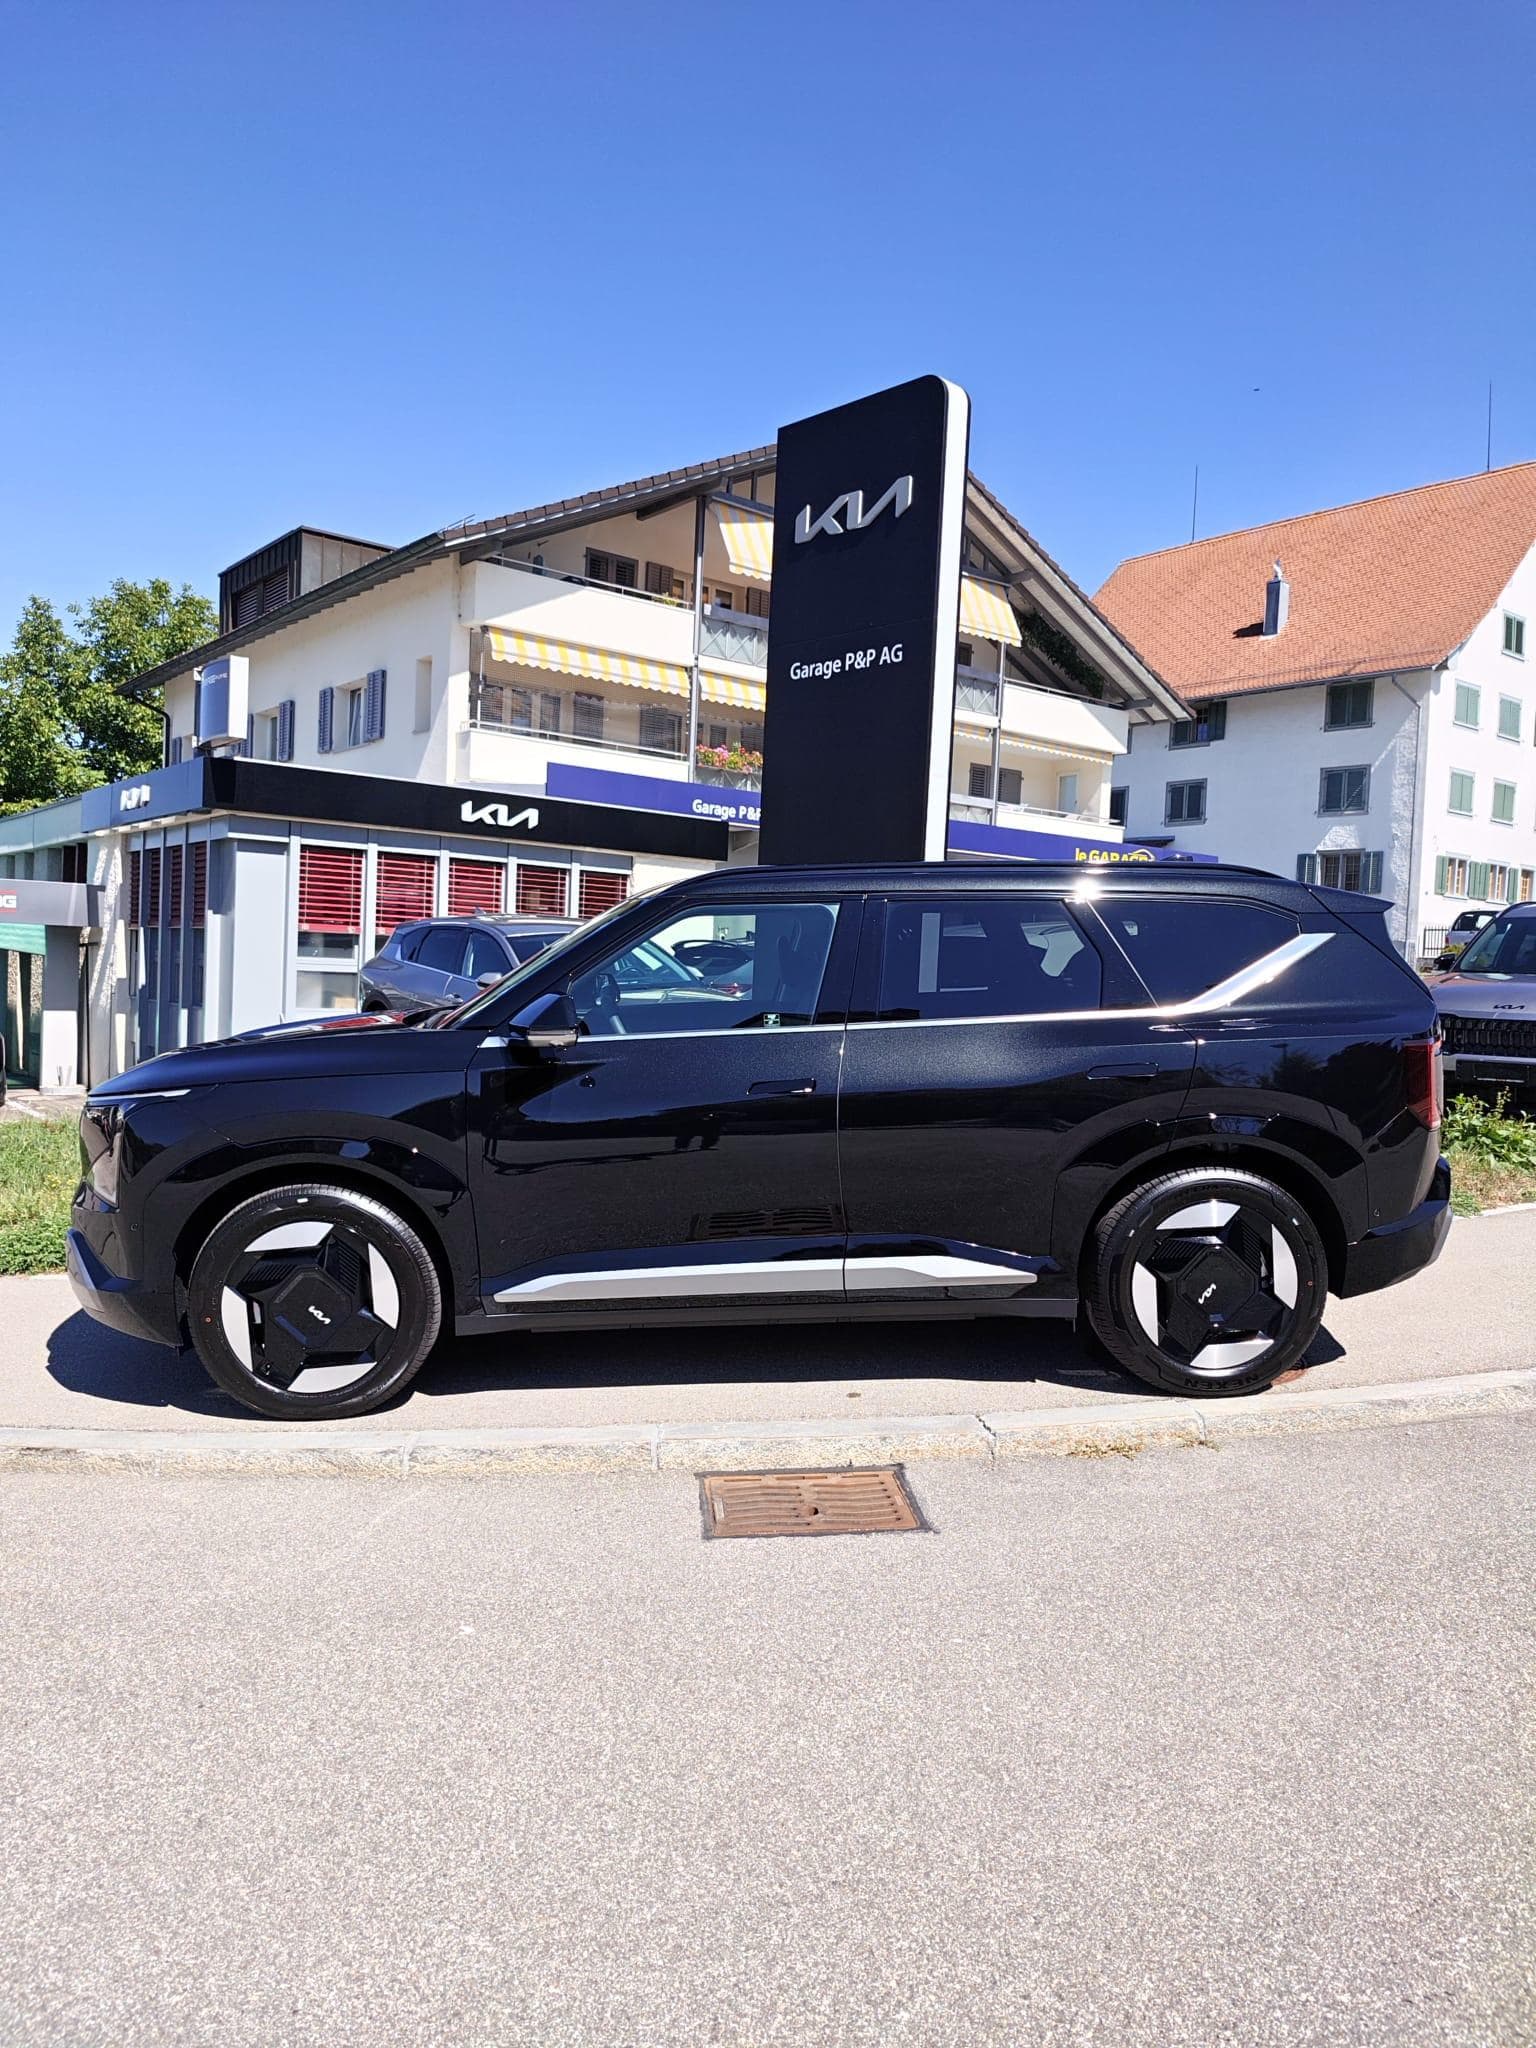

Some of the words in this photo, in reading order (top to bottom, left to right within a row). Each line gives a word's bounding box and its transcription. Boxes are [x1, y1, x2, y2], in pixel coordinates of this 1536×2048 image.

[790, 659, 841, 680] Garage
[845, 649, 876, 671] P&P
[879, 644, 903, 665] AG
[692, 798, 736, 820] Garage
[1184, 1374, 1259, 1390] NEXEN
